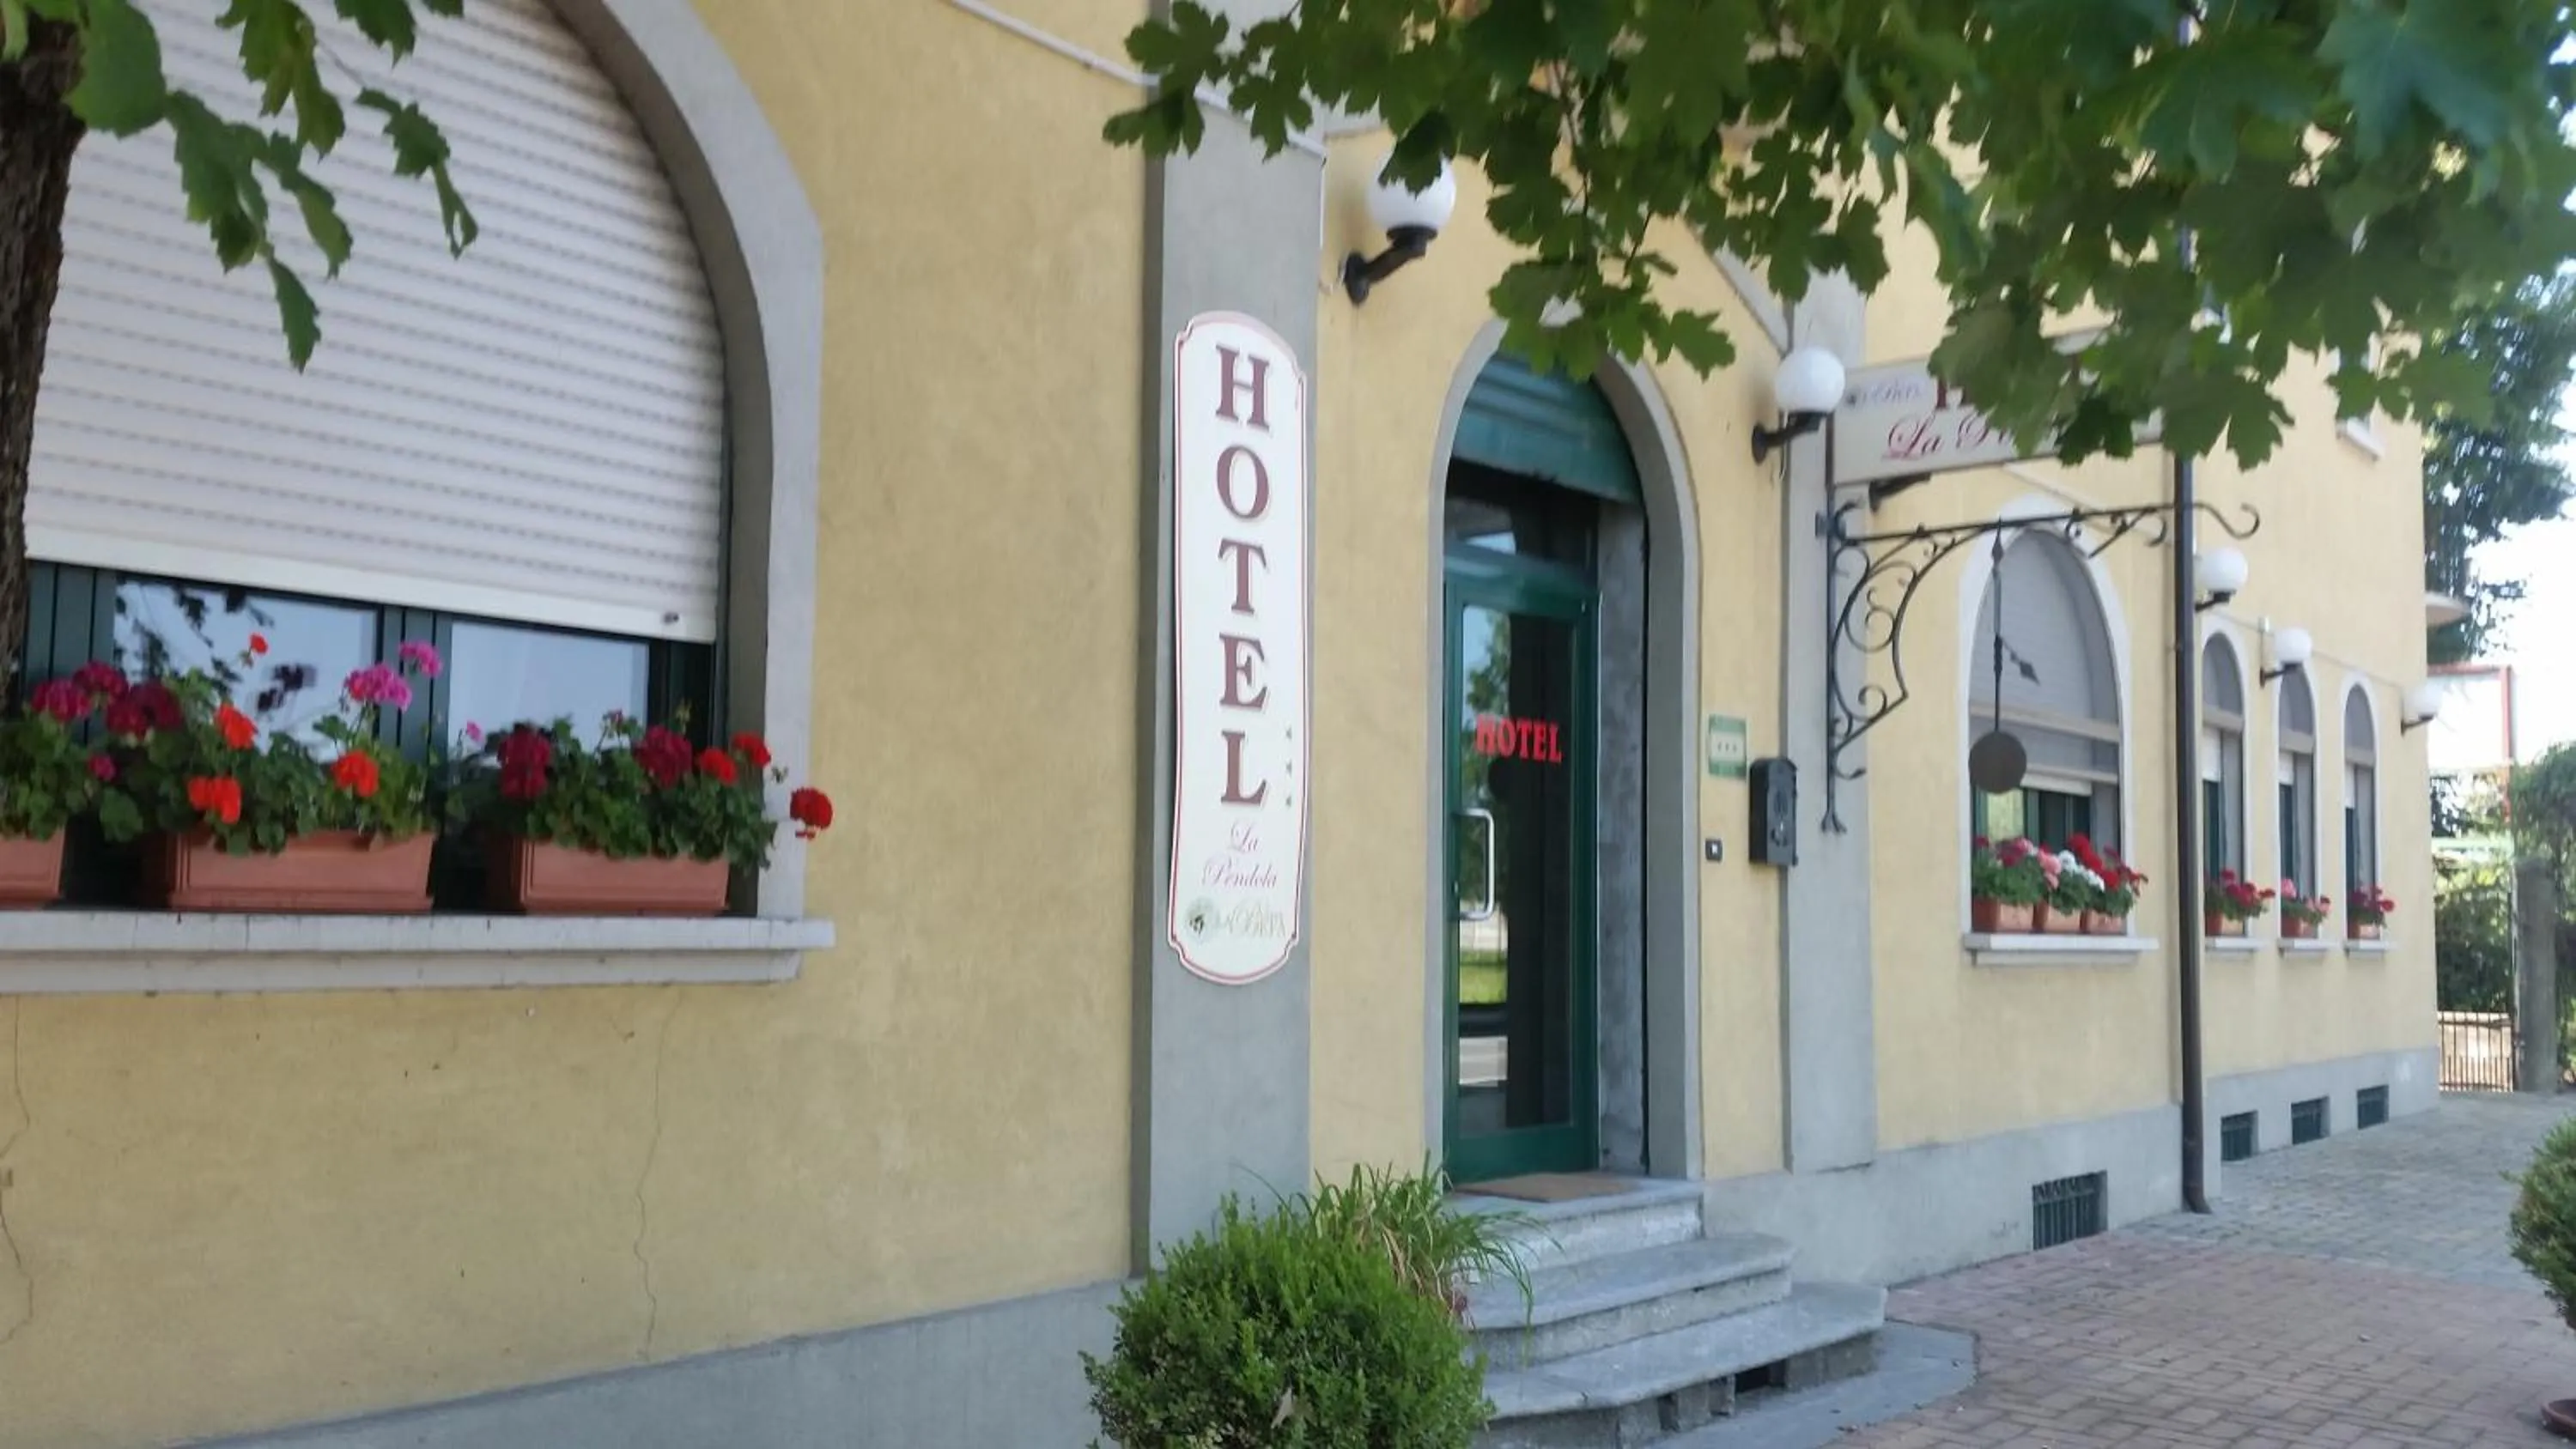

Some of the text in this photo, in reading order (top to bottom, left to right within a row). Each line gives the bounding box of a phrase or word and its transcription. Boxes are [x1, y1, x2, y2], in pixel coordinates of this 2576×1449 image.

[1880, 410, 1944, 462] La
[1214, 343, 1271, 809] HOTEL
[1474, 712, 1563, 764] HOTEL
[1225, 816, 1259, 853] La
